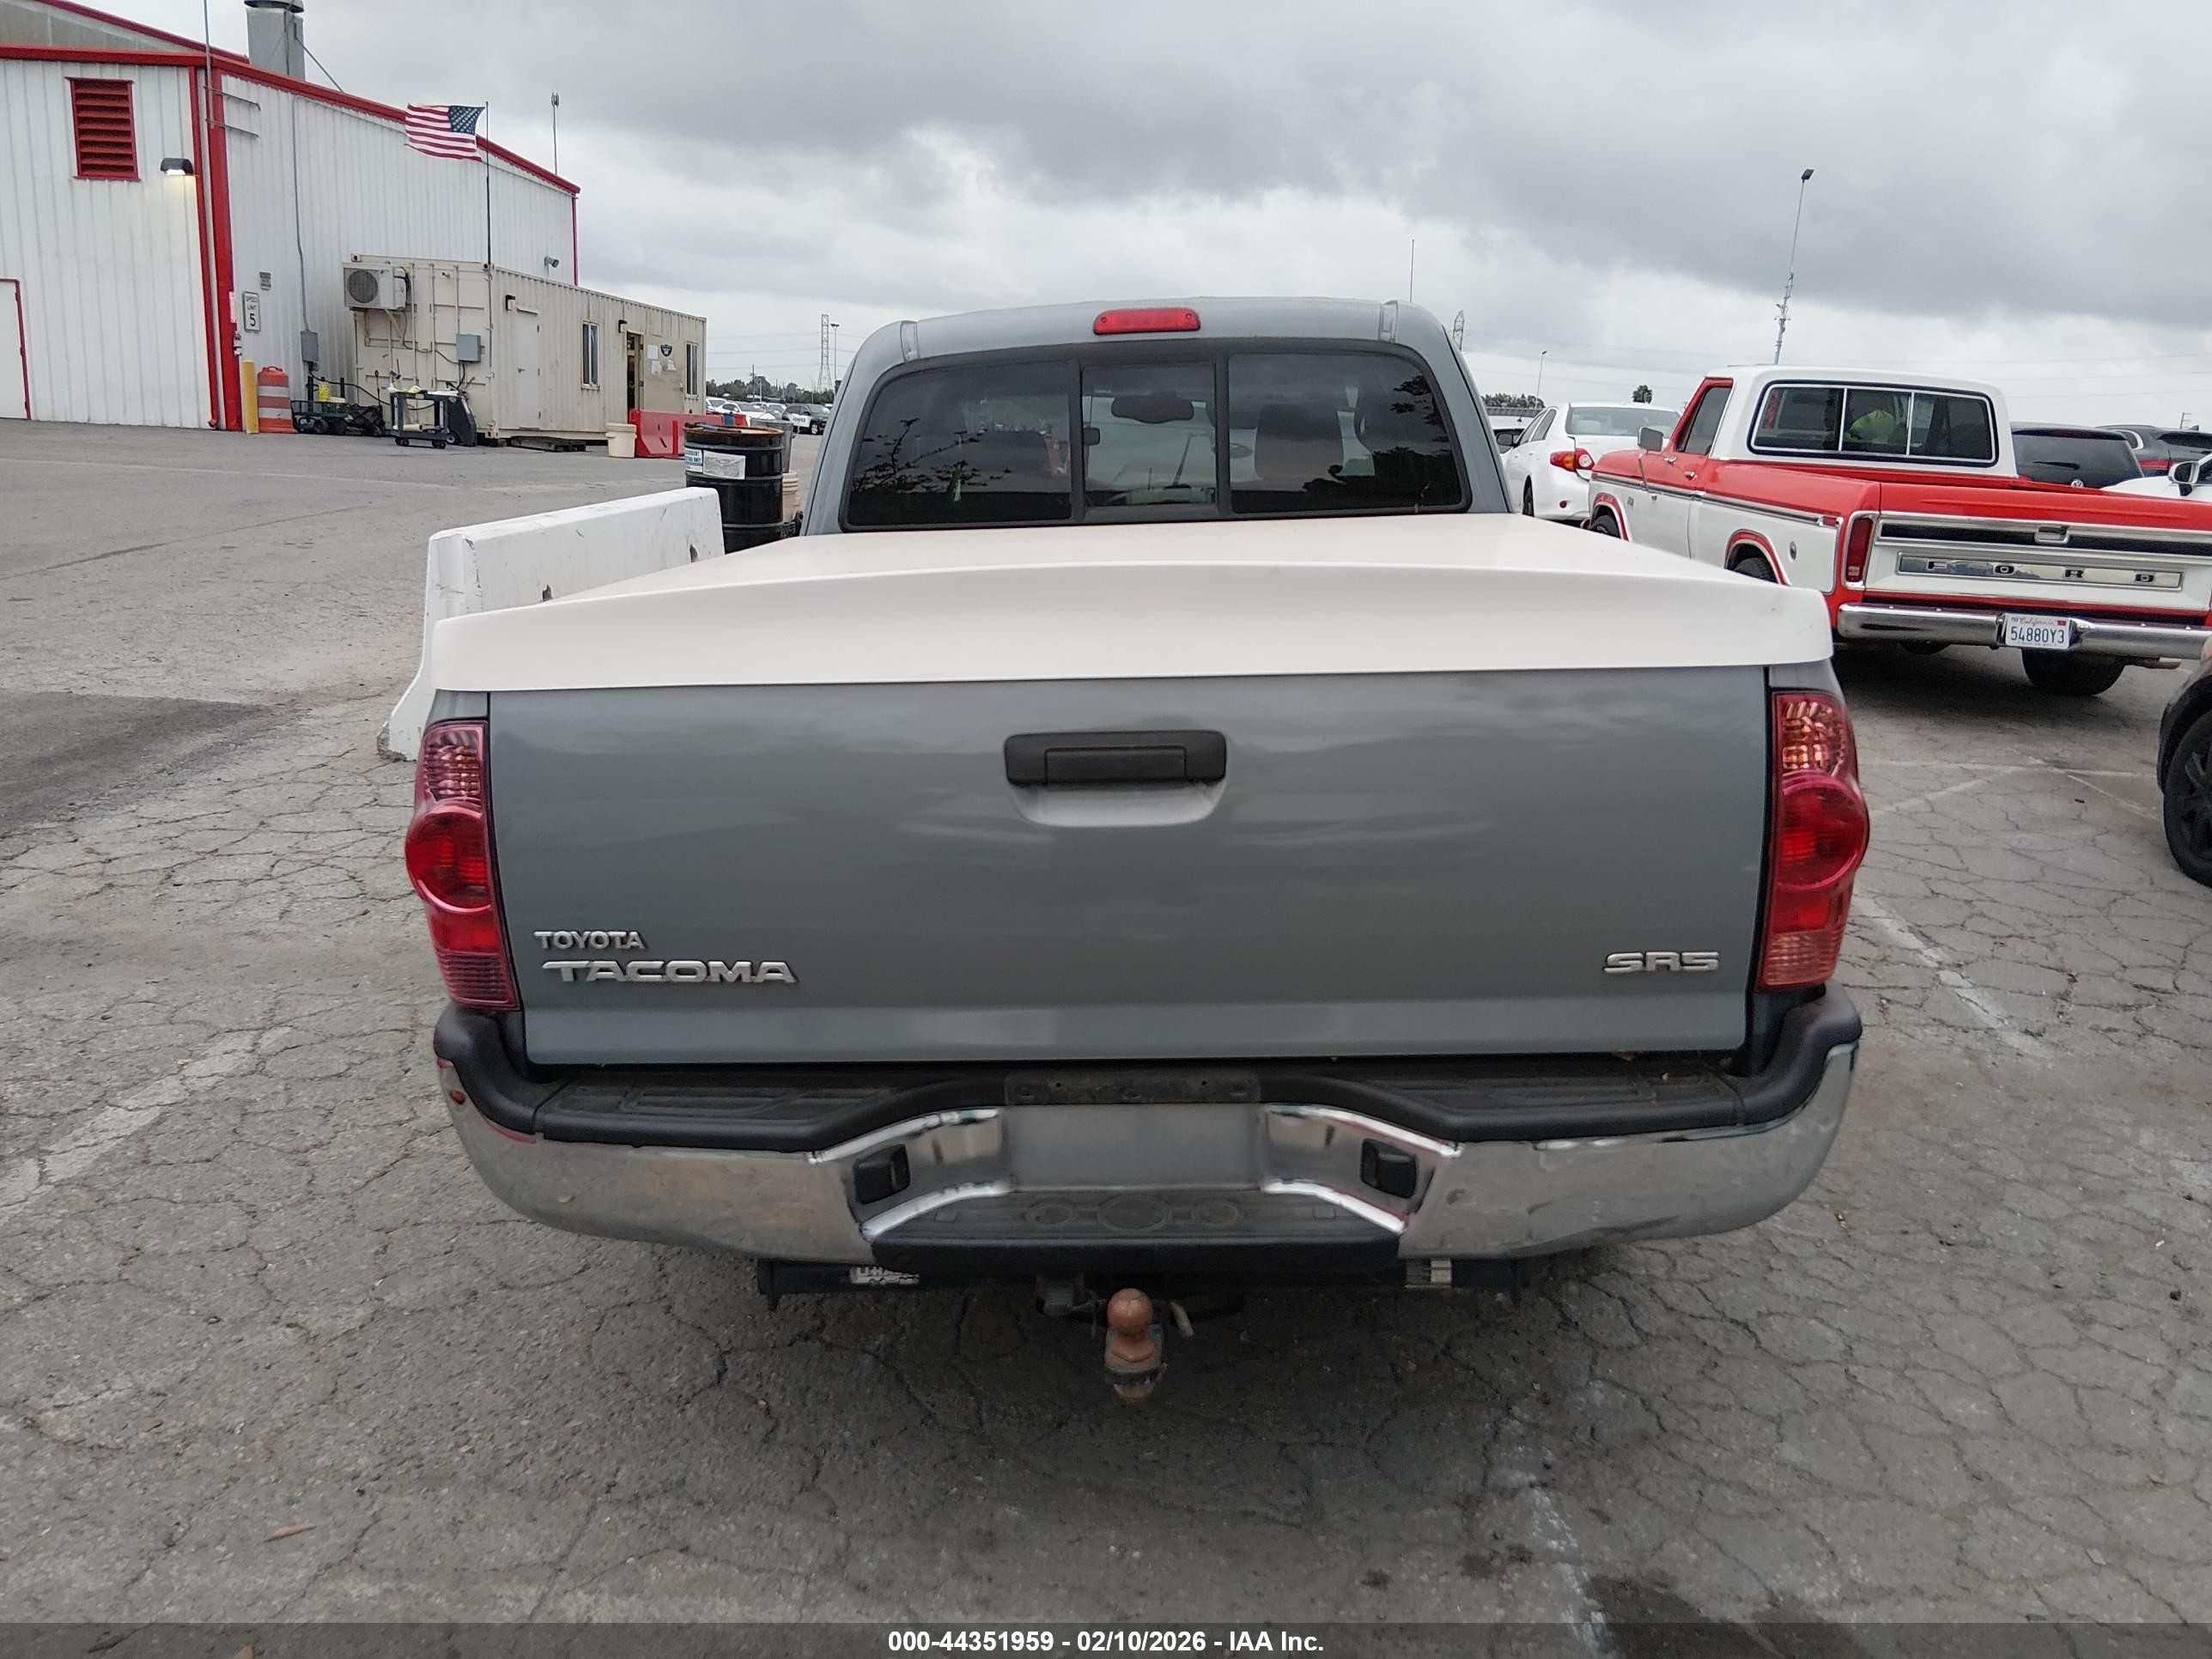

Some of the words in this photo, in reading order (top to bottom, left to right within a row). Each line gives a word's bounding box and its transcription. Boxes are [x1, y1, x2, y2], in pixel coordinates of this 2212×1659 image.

[249, 313, 257, 327] 5
[1927, 561, 2154, 583] FORD
[2010, 626, 2064, 644] 54880Y3
[533, 931, 646, 950] TOYOTA
[542, 960, 798, 983] TACOMA
[1603, 951, 1720, 974] SR5
